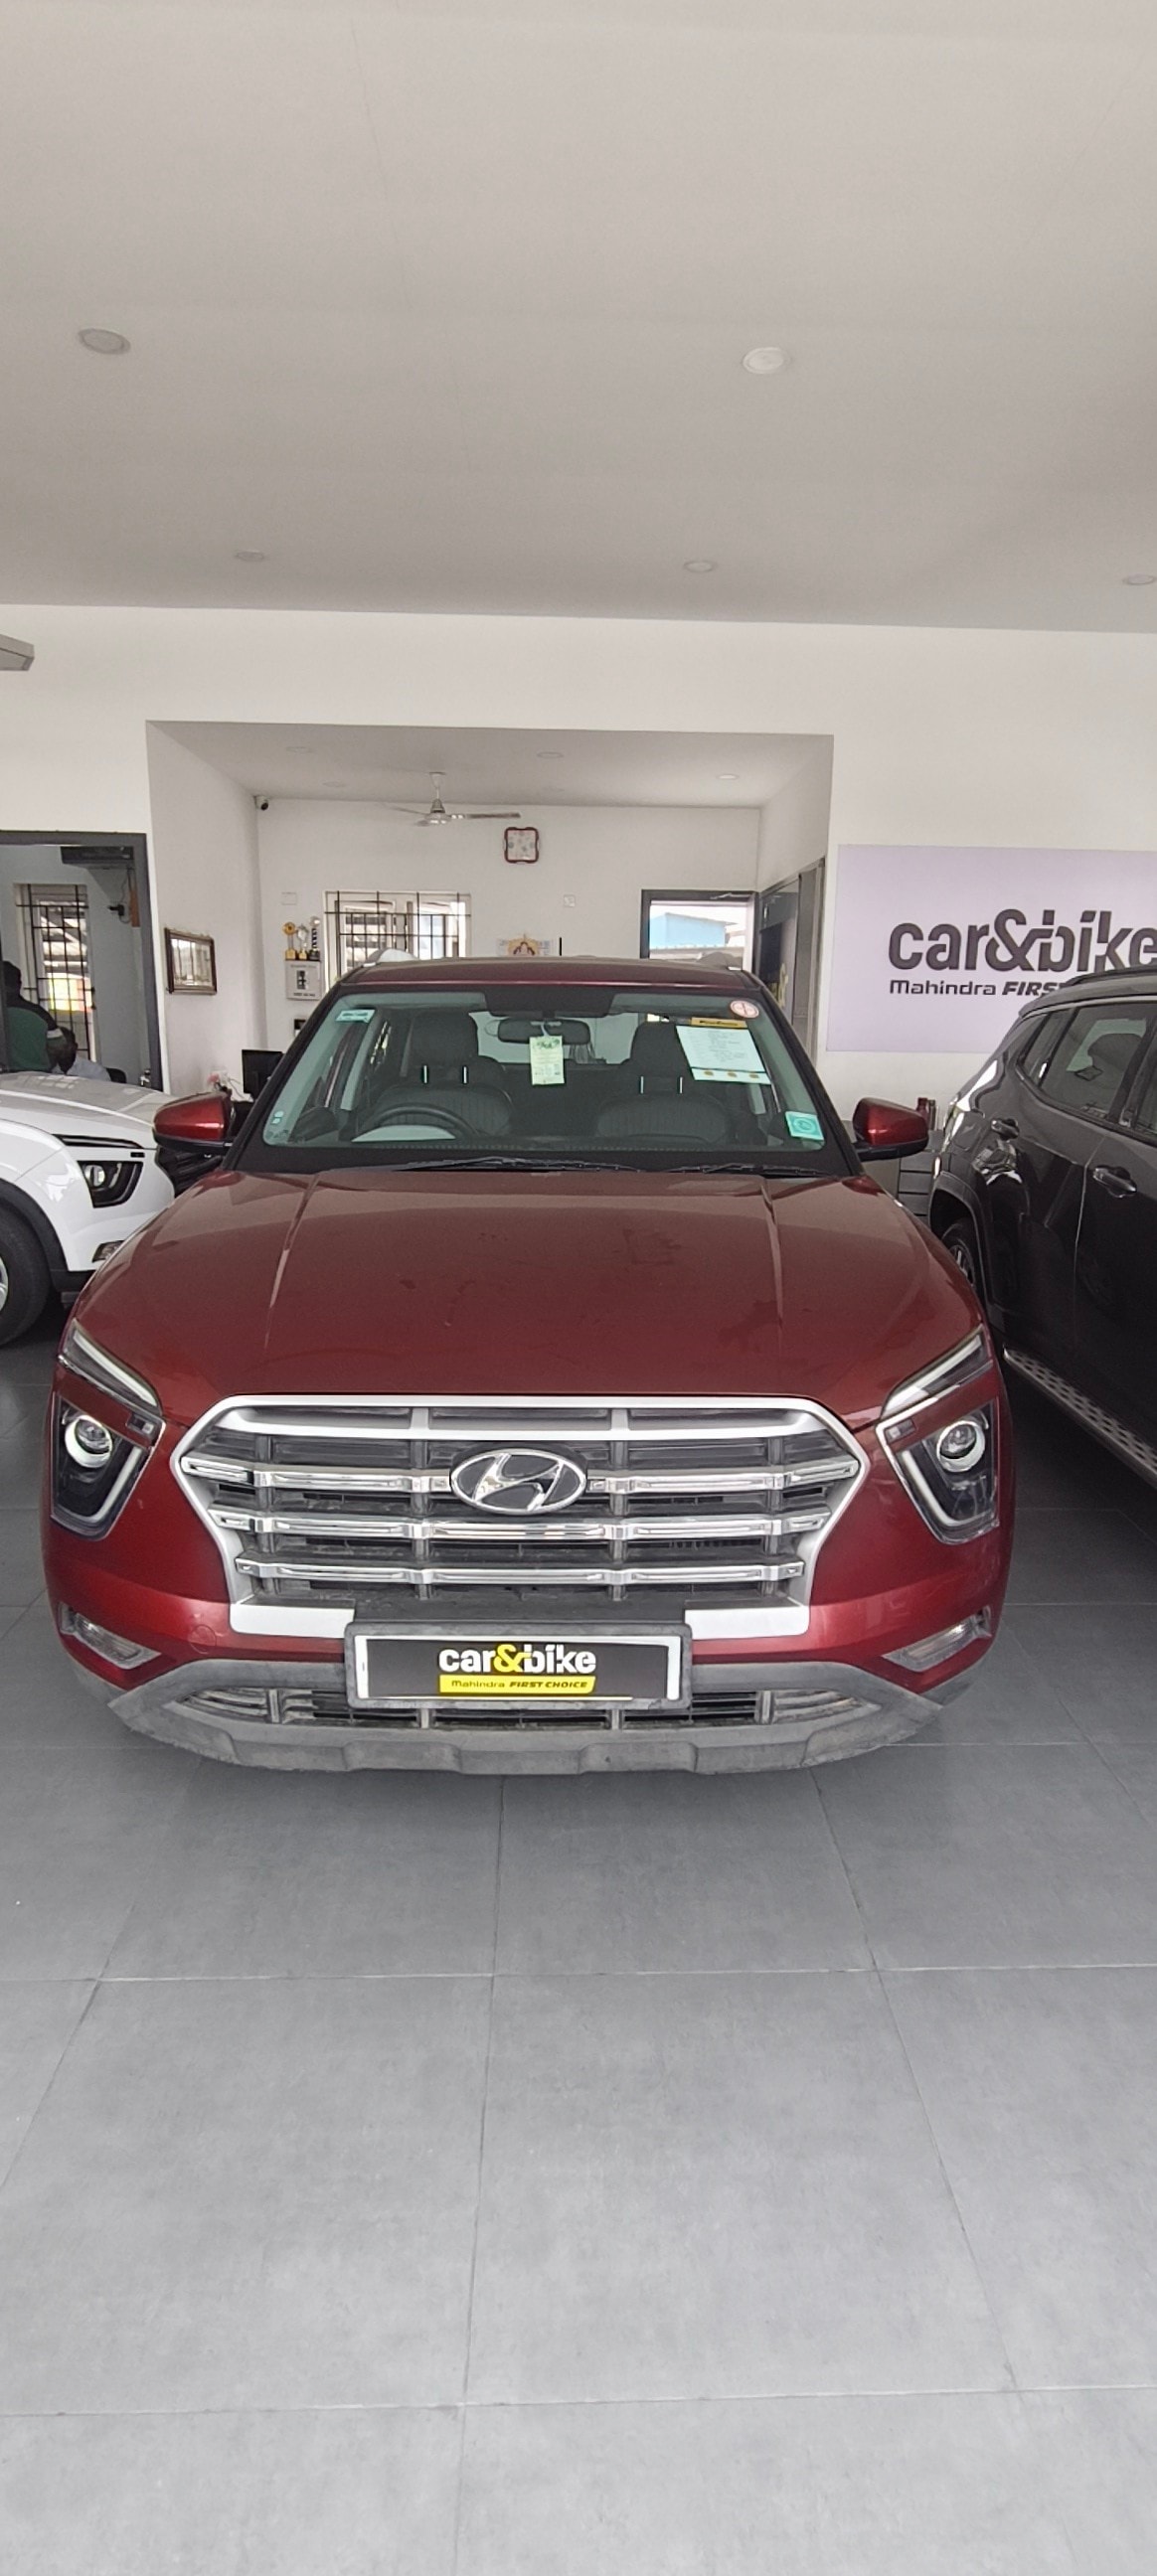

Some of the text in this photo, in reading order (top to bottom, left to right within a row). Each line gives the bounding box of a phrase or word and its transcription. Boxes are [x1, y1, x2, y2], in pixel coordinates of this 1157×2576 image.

[889, 908, 1157, 973] car&bike
[890, 980, 996, 996] Mahindra
[438, 1643, 596, 1675] car&bike
[451, 1680, 505, 1689] Mahindra
